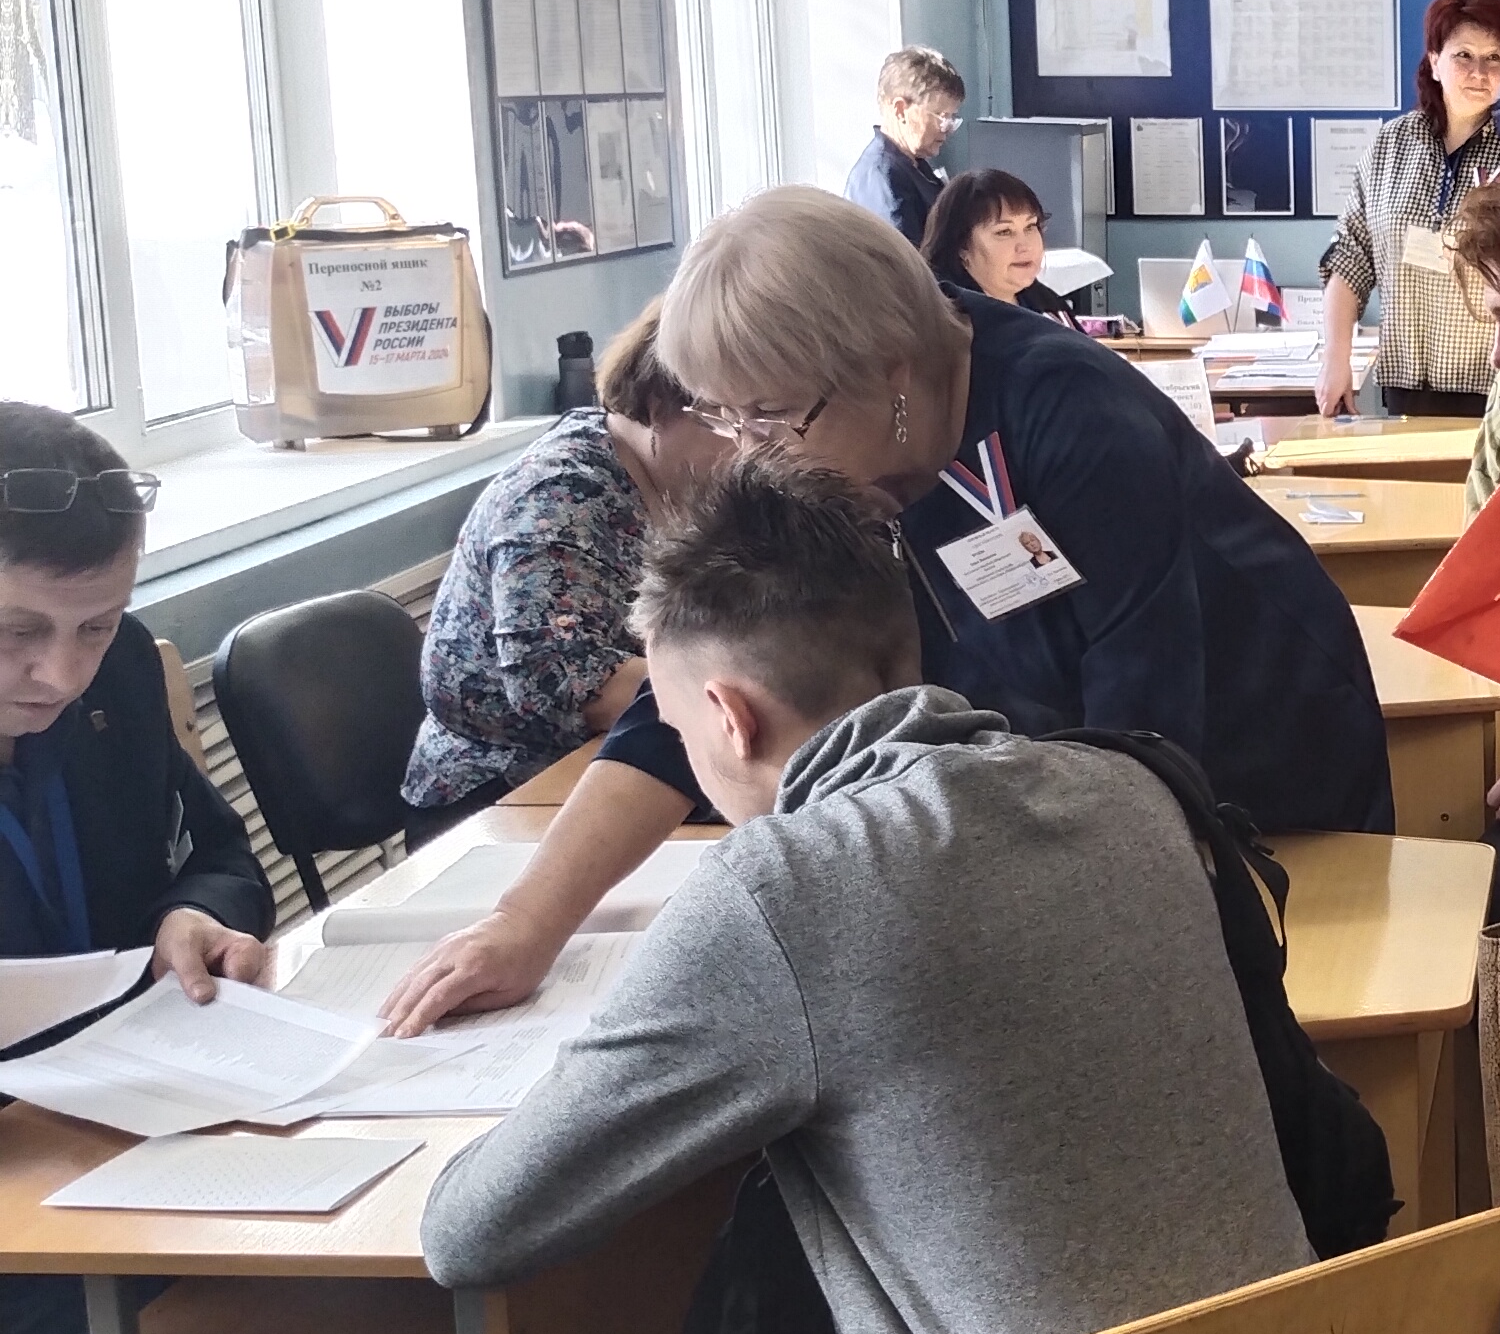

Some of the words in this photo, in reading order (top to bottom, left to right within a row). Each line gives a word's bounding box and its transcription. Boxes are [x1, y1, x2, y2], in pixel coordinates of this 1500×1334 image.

[309, 259, 388, 276] Переносной
[391, 258, 428, 269] ящик
[360, 280, 383, 292] №2
[383, 302, 440, 318] ВЫБОРЫ
[377, 317, 458, 334] ПРЕЗИДЕНТА
[373, 335, 425, 351] РОССИИ
[395, 350, 426, 362] МАРТА
